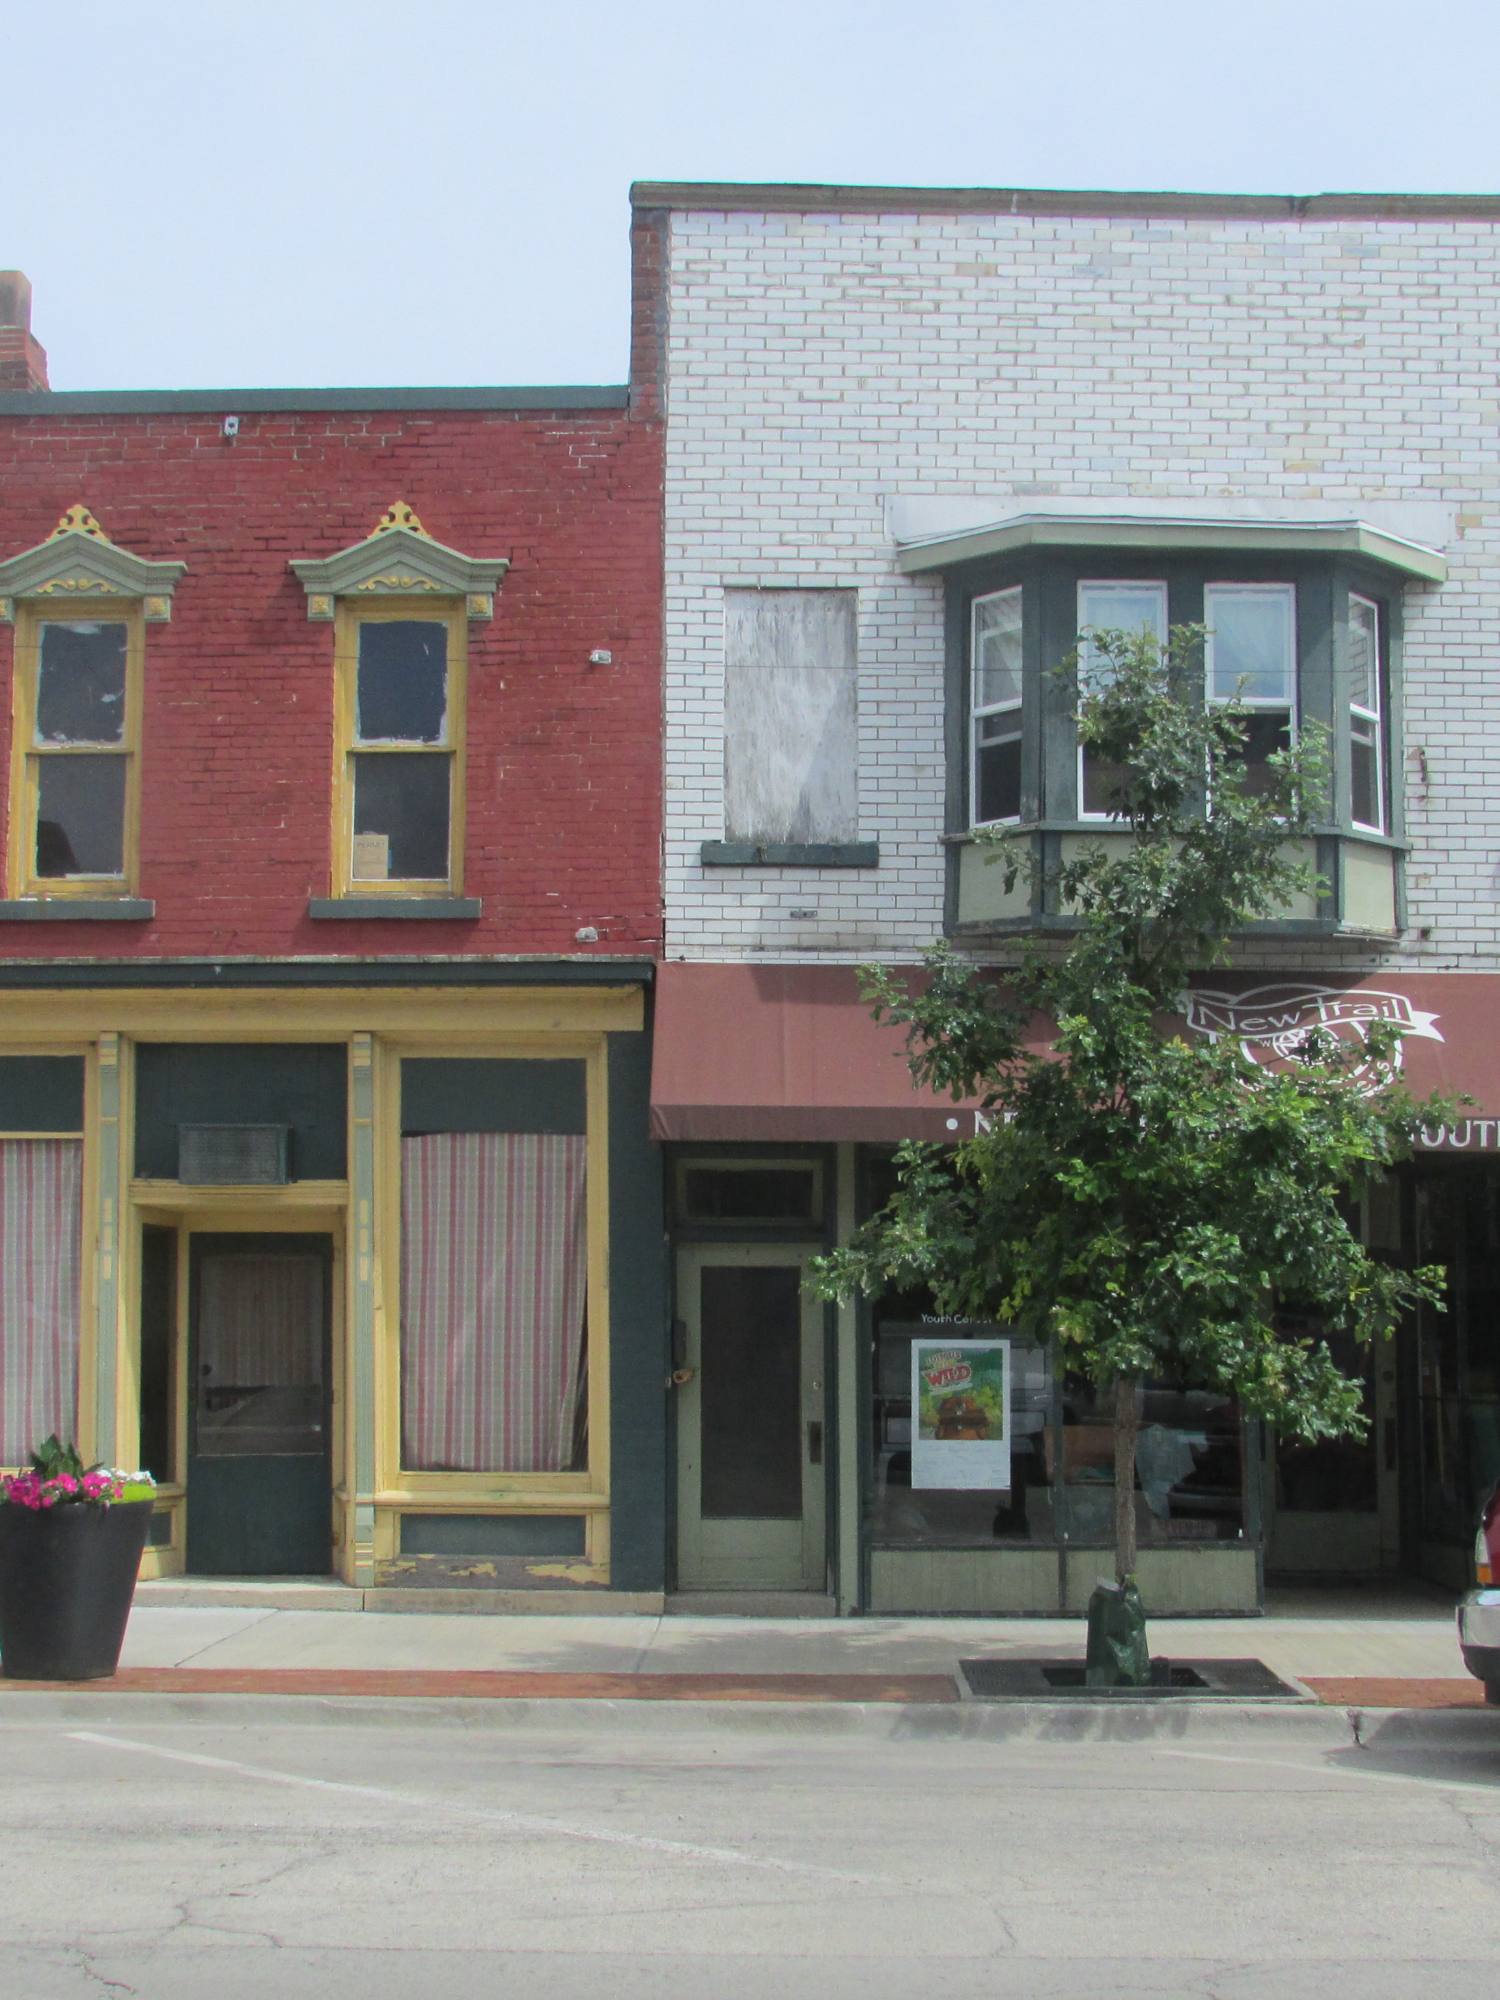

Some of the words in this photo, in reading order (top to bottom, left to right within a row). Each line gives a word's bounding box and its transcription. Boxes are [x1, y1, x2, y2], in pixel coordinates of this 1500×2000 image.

[1198, 1006, 1301, 1031] New
[1302, 997, 1402, 1023] Trail
[1400, 1119, 1500, 1147] OUT
[921, 1312, 952, 1325] Youth
